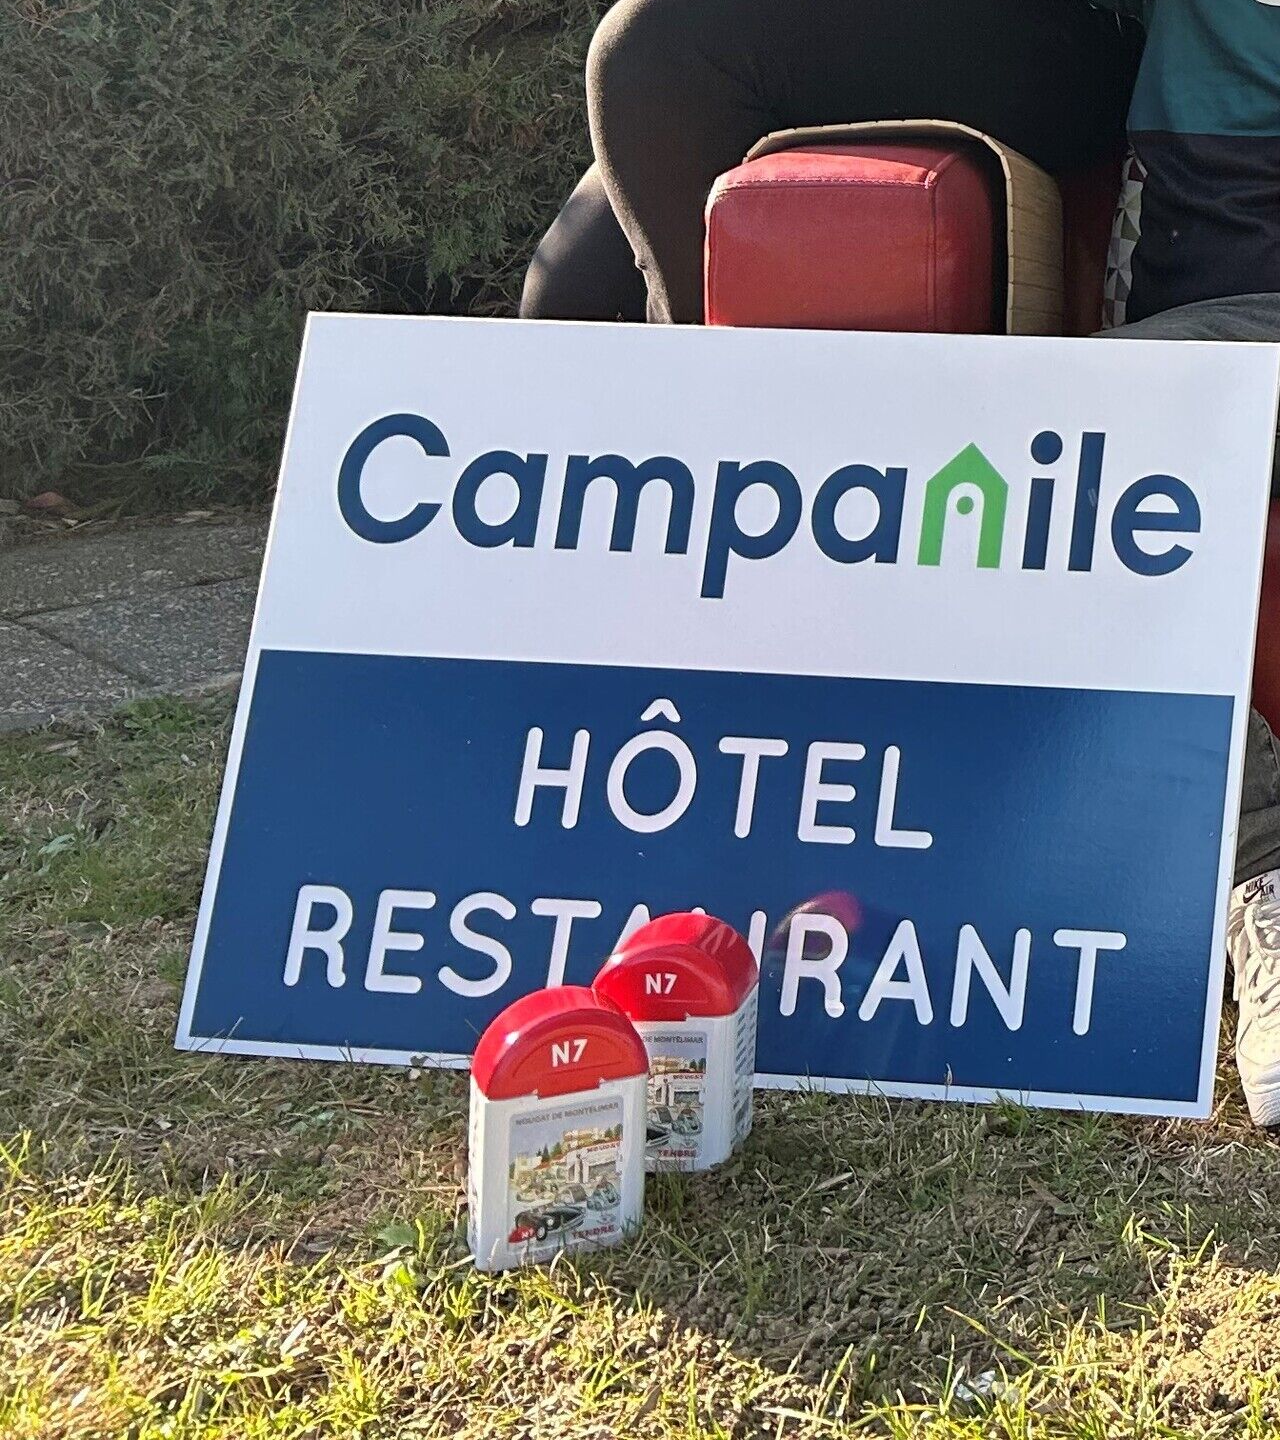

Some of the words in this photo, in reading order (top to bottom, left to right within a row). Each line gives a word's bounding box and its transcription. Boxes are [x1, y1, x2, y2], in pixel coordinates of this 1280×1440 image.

[337, 412, 1202, 599] Campanile
[513, 698, 933, 850] HÔTEL
[644, 972, 678, 995] N7
[551, 1038, 588, 1068] N7
